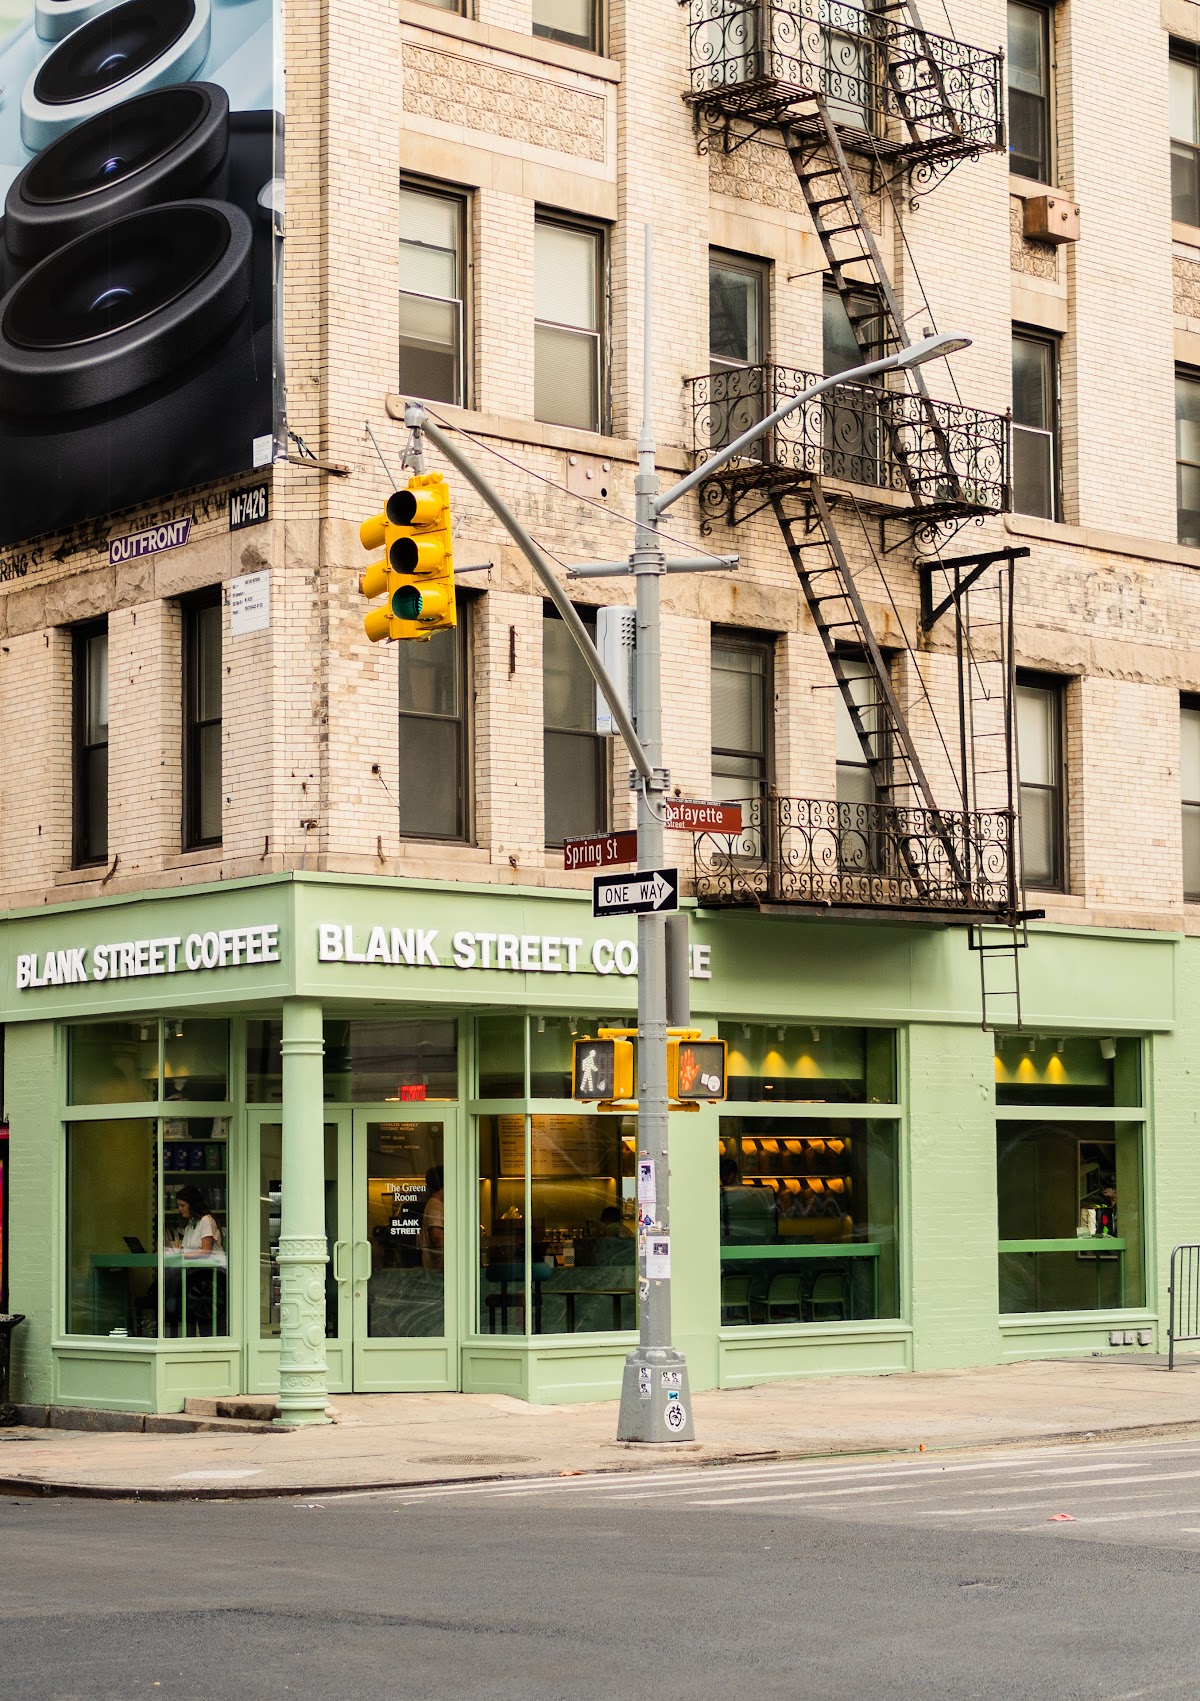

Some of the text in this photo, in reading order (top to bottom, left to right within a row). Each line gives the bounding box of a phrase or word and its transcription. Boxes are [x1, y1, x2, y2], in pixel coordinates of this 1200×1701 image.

[111, 520, 187, 562] OUTFRONT
[666, 804, 723, 825] Lafayette
[666, 821, 685, 829] Street
[566, 839, 618, 869] Spring St
[605, 882, 665, 904] ONE WAY
[16, 923, 280, 989] BLANK STREET COFFEE
[318, 923, 712, 978] BLANK STREET COE
[385, 1183, 426, 1192] The Green
[394, 1192, 418, 1202] Room
[390, 1227, 421, 1235] STREET
[392, 1219, 419, 1227] BLANK
